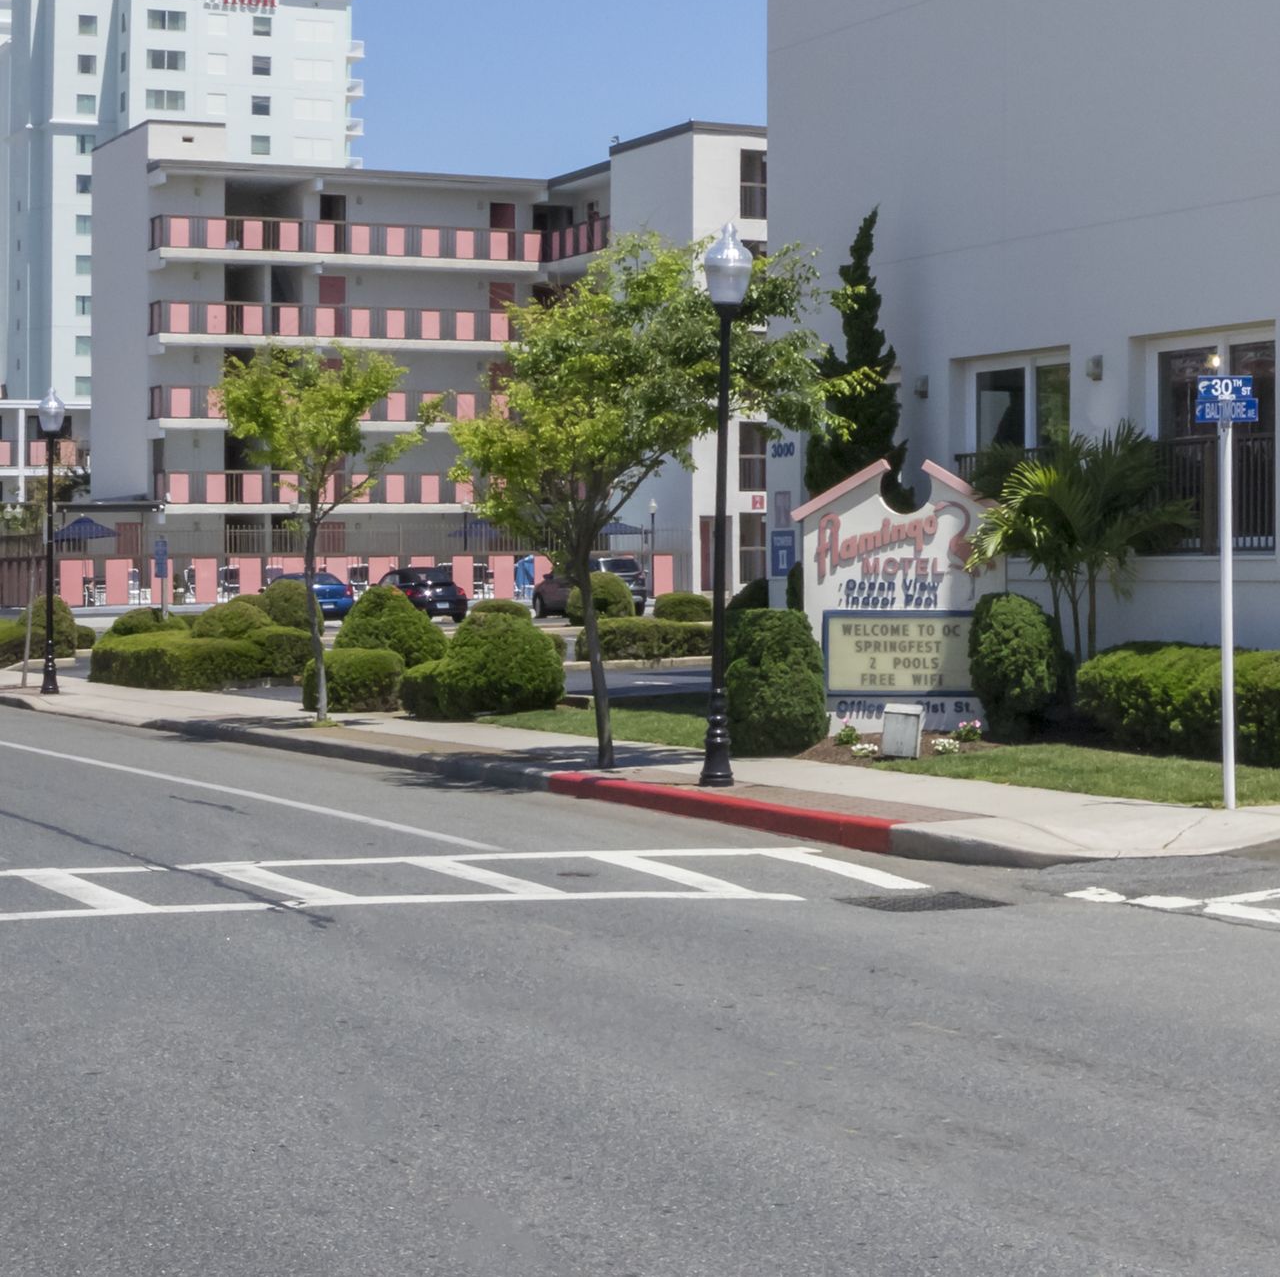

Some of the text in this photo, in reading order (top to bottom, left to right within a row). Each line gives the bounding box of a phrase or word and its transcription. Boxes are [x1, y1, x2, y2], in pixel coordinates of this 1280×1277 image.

[1241, 387, 1251, 395] ST
[1205, 403, 1246, 418] BALTIMORE
[771, 442, 795, 458] 3000
[862, 555, 945, 576] MOTEL
[846, 578, 939, 592] Ocean View
[845, 594, 938, 607] Indoor Pool
[842, 624, 961, 637] WELCOME TO OC
[855, 641, 942, 654] SPRINGFEST
[869, 657, 940, 670] 2 POOLS
[861, 673, 944, 686] FREE WIFI
[837, 700, 884, 713] Office
